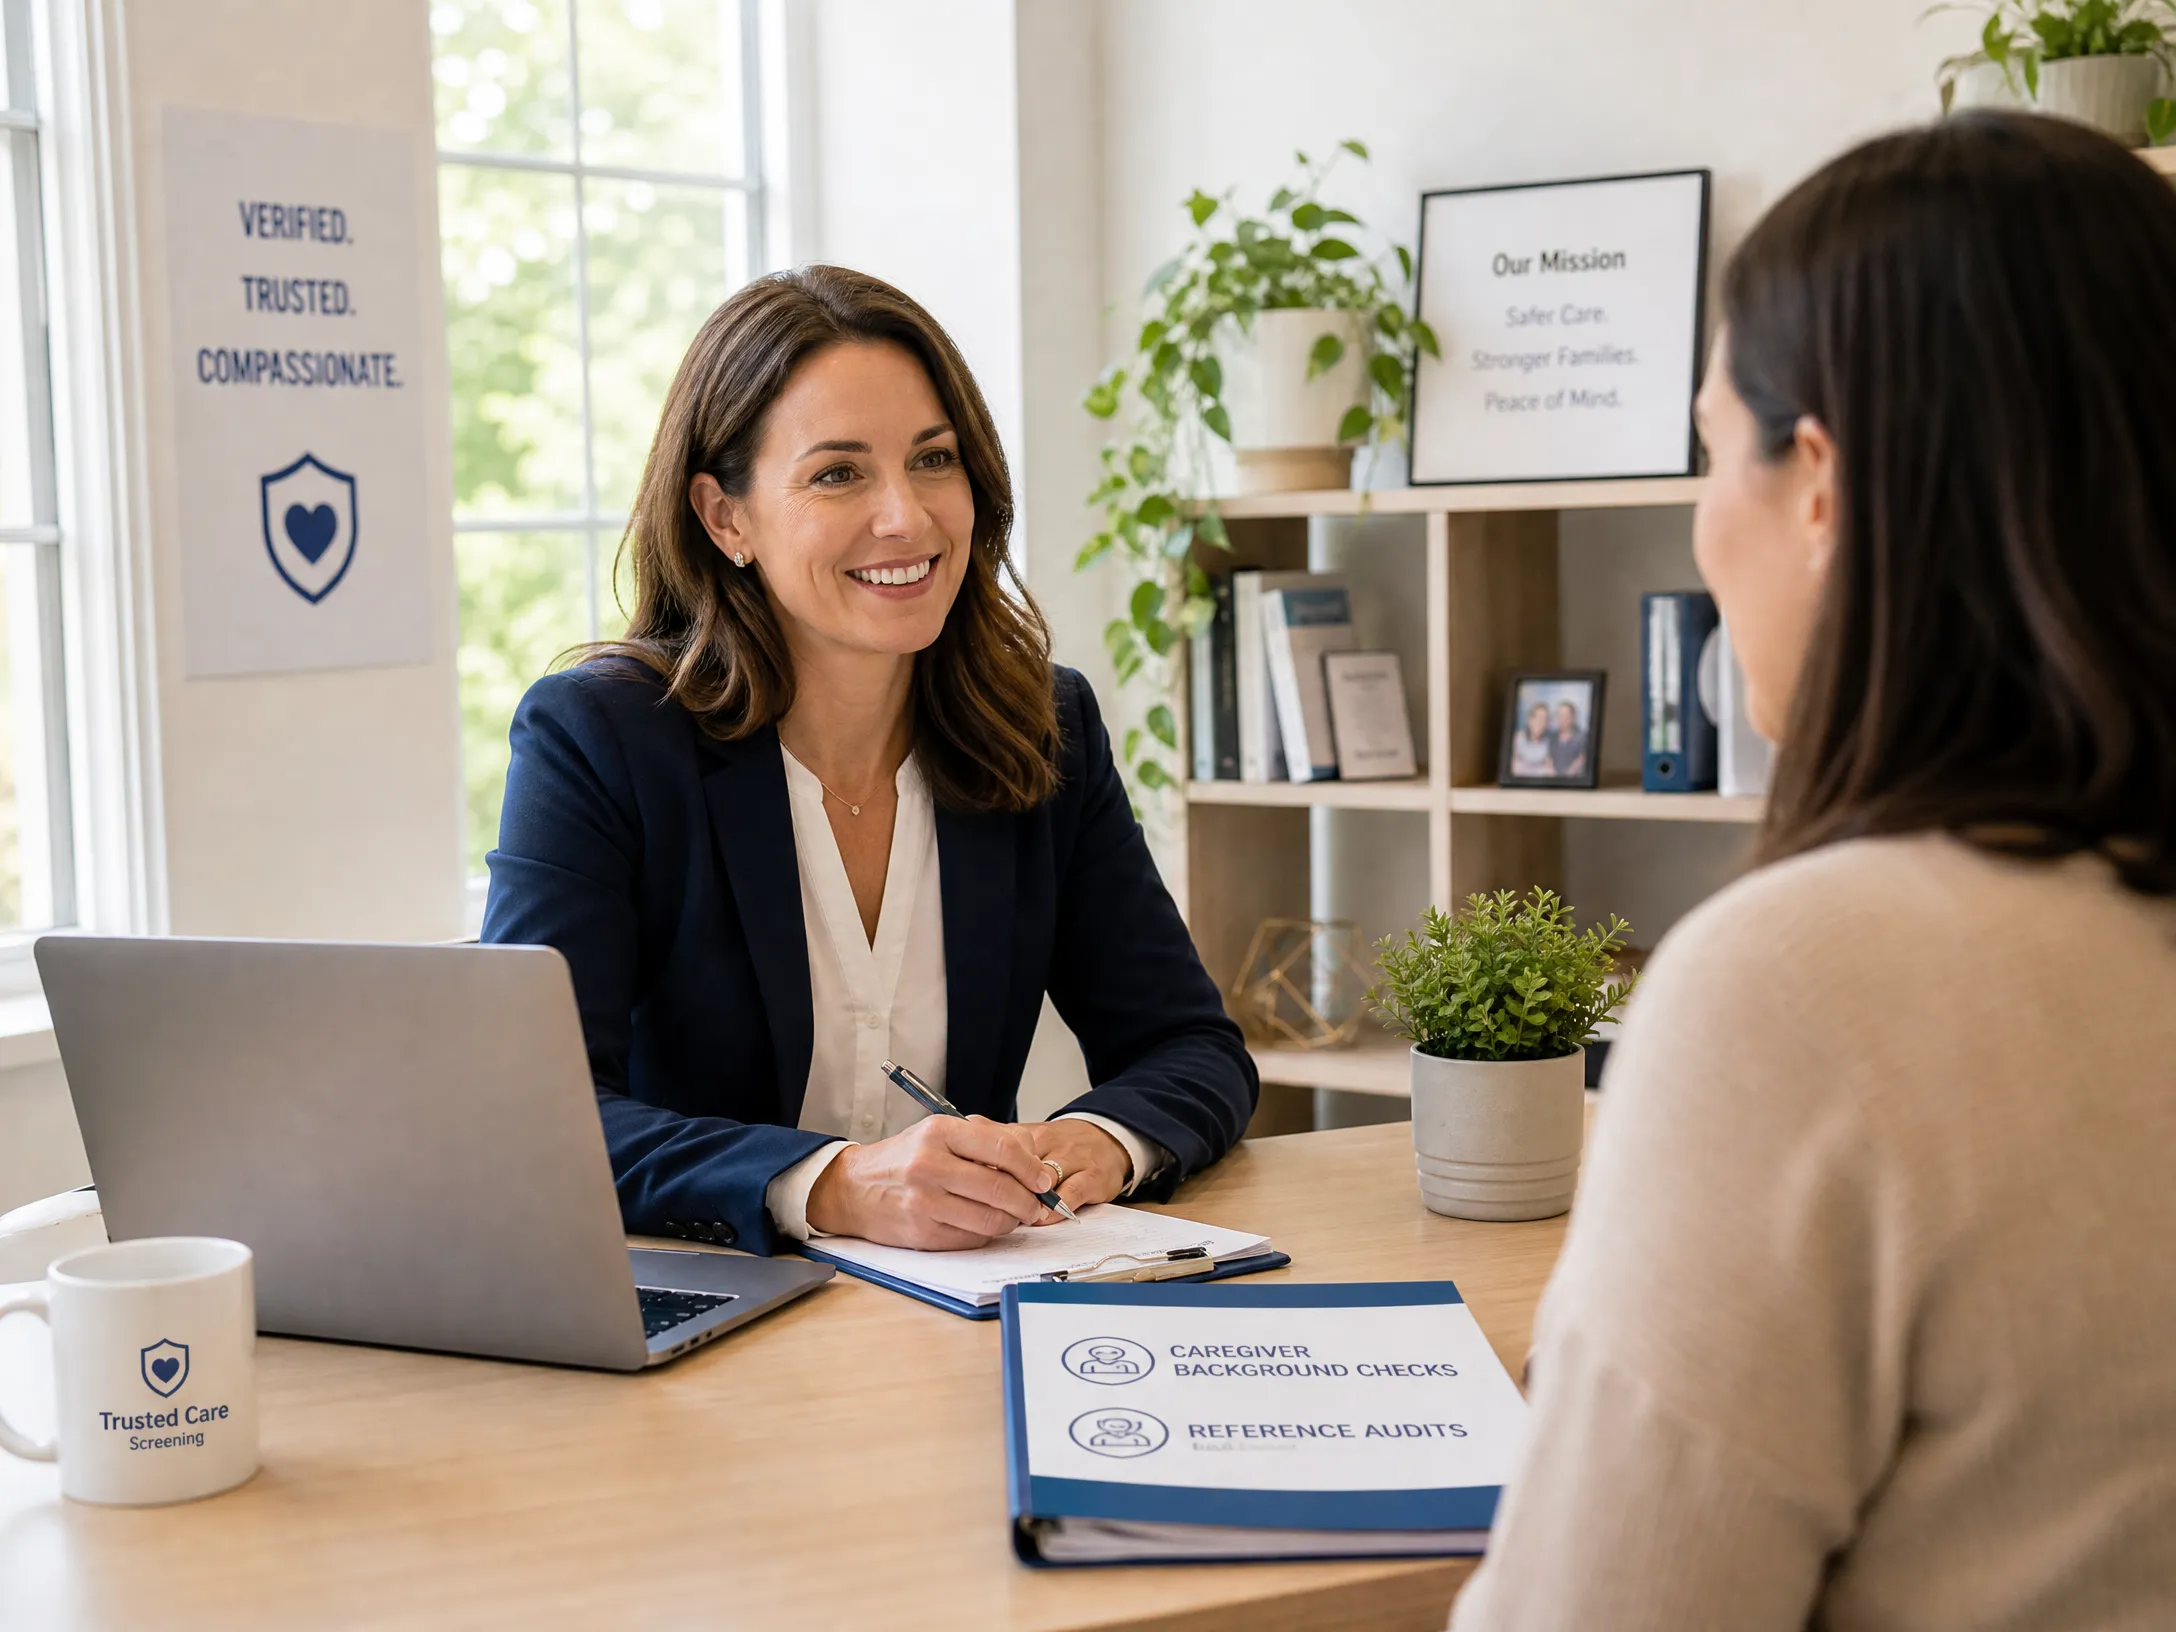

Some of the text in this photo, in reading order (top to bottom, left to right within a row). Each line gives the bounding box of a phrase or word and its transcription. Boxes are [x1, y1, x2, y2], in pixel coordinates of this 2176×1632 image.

[238, 200, 354, 245] VERIFIED.
[1491, 248, 1626, 277] Our Mission
[240, 274, 357, 317] TRUSTED.
[1504, 303, 1609, 329] Safer Care.
[196, 346, 404, 389] COMPASSIONATE.
[1470, 348, 1552, 374] Stronger
[1483, 391, 1540, 413] Peace
[1543, 388, 1564, 411] of
[1169, 1344, 1312, 1359] CAREGIVER
[1173, 1363, 1459, 1378] BACKGROUND CHECKS
[98, 1404, 229, 1431] Trusted Care
[129, 1431, 205, 1451] Screening
[1187, 1423, 1468, 1439] REFERENCE AUDITS
